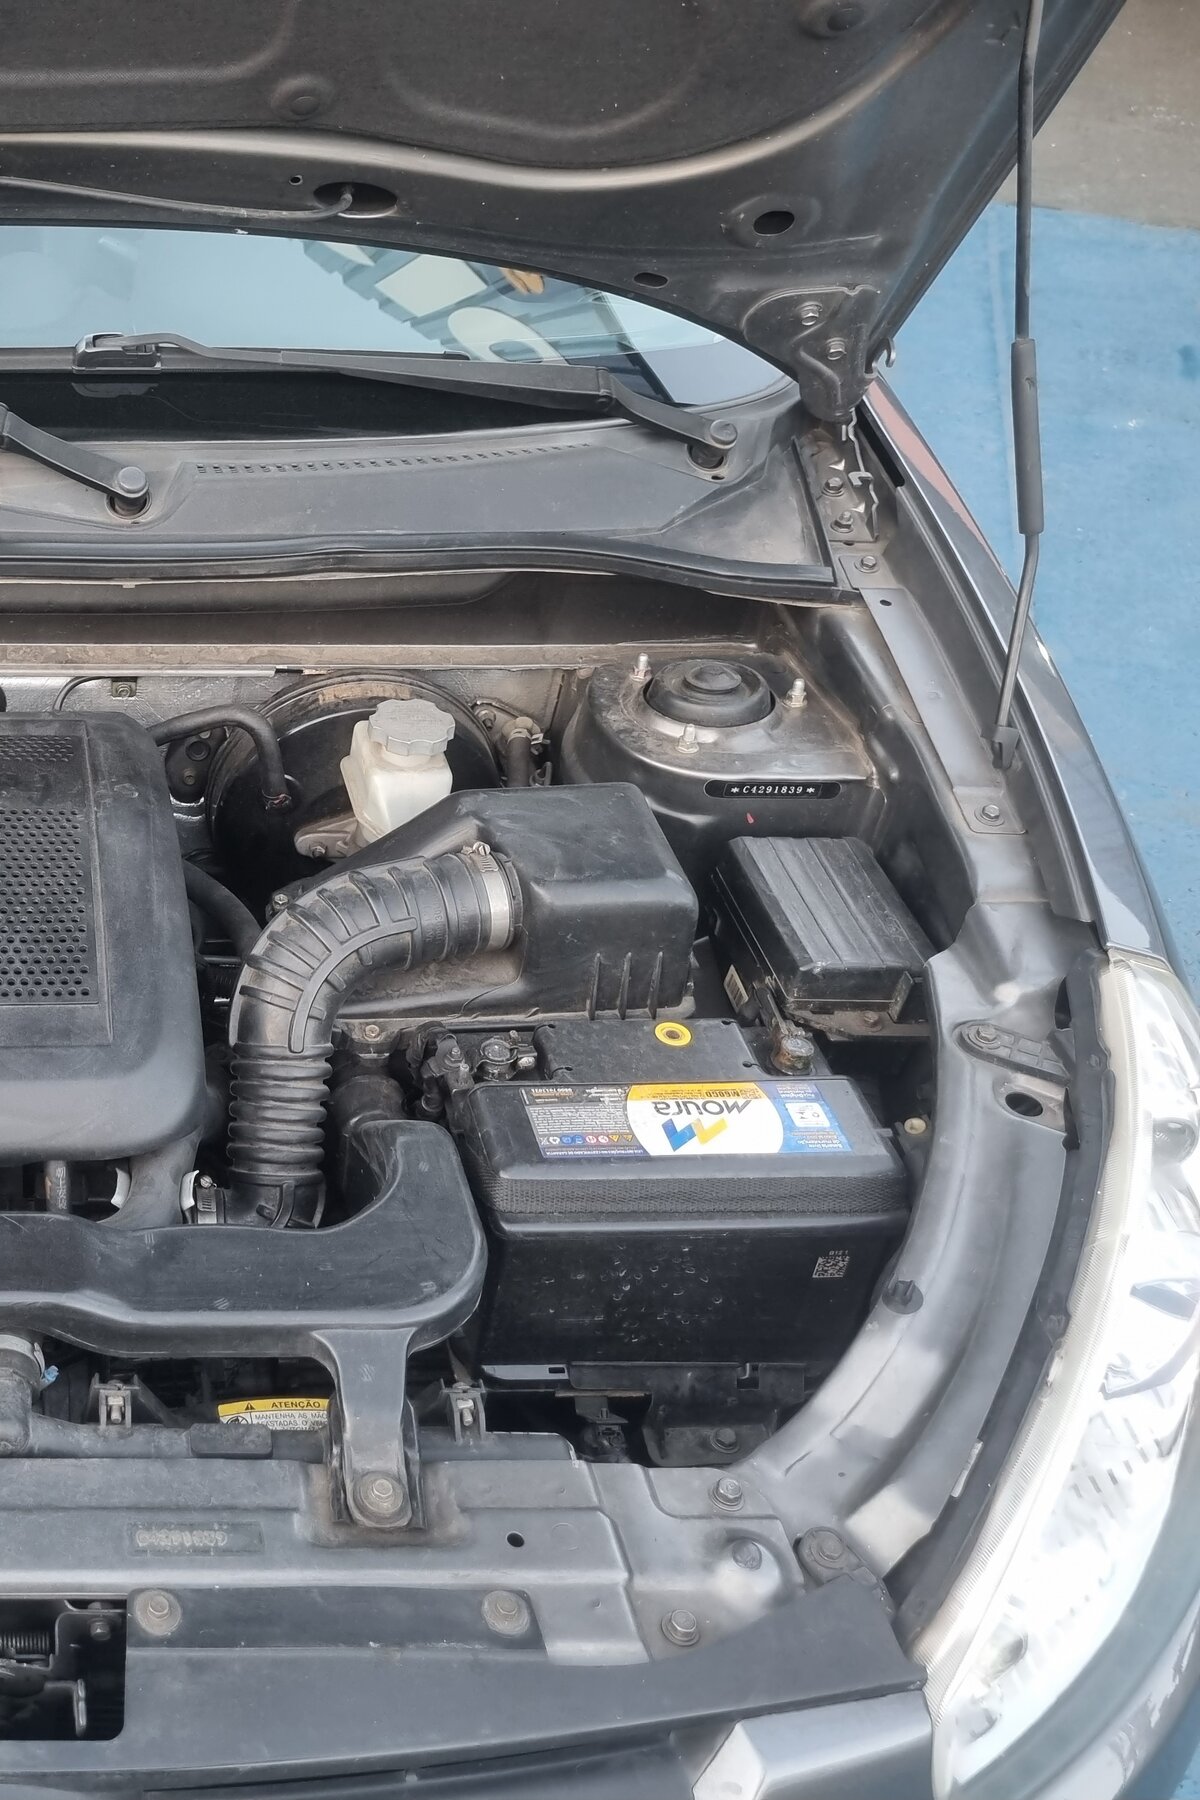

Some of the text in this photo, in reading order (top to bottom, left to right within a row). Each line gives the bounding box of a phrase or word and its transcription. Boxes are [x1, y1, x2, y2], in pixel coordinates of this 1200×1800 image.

[742, 785, 803, 794] C4291839
[271, 1400, 321, 1409] ATENÇÃO
[255, 1412, 295, 1420] MANTENHA
